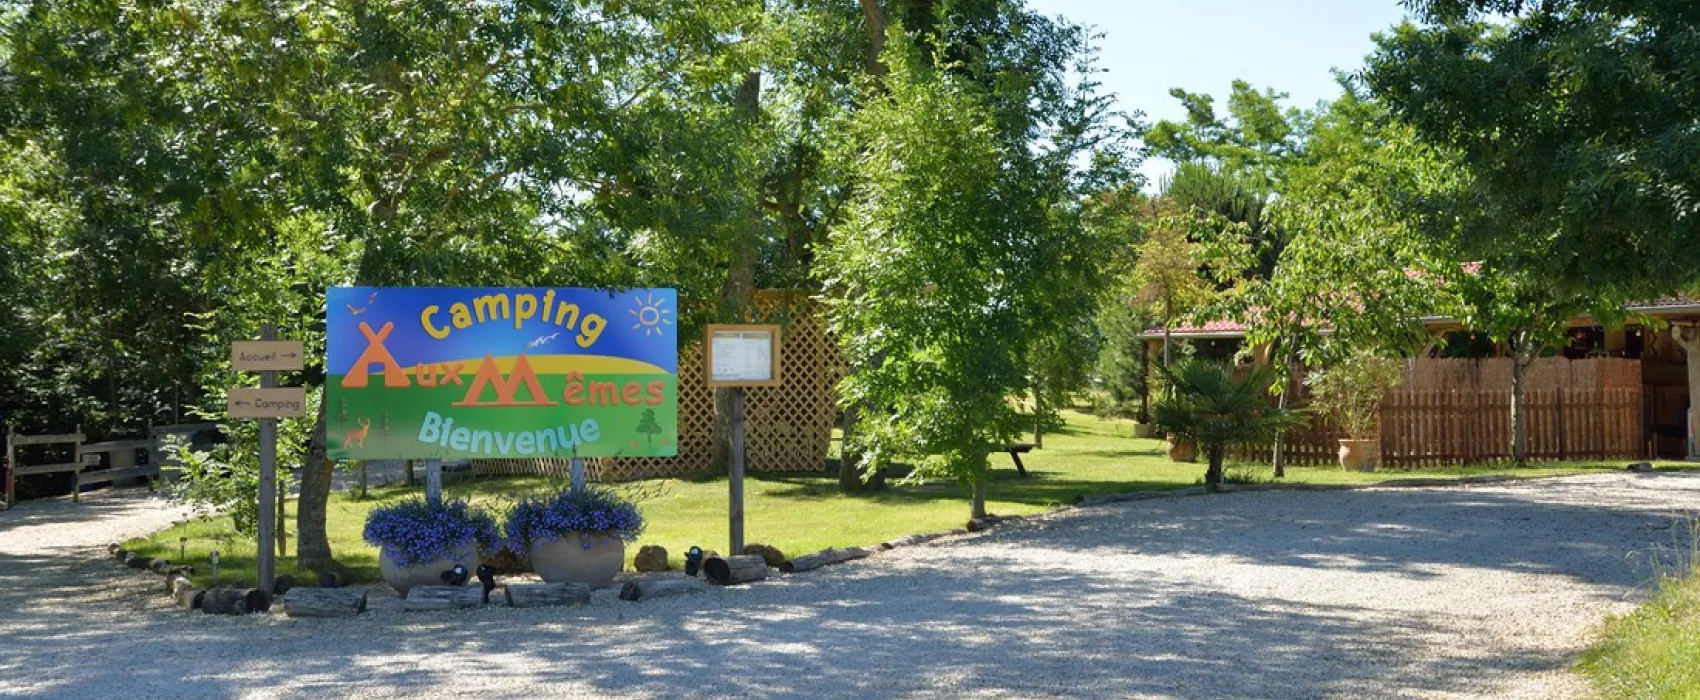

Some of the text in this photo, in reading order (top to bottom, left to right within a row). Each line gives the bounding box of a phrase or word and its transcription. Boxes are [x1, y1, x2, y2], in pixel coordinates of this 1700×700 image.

[420, 289, 607, 348] Camping
[239, 350, 277, 361] Accueil
[341, 321, 465, 388] Aux
[450, 352, 665, 407] Mêmes
[254, 397, 299, 410] Camping
[418, 411, 600, 455] Bienvenue
